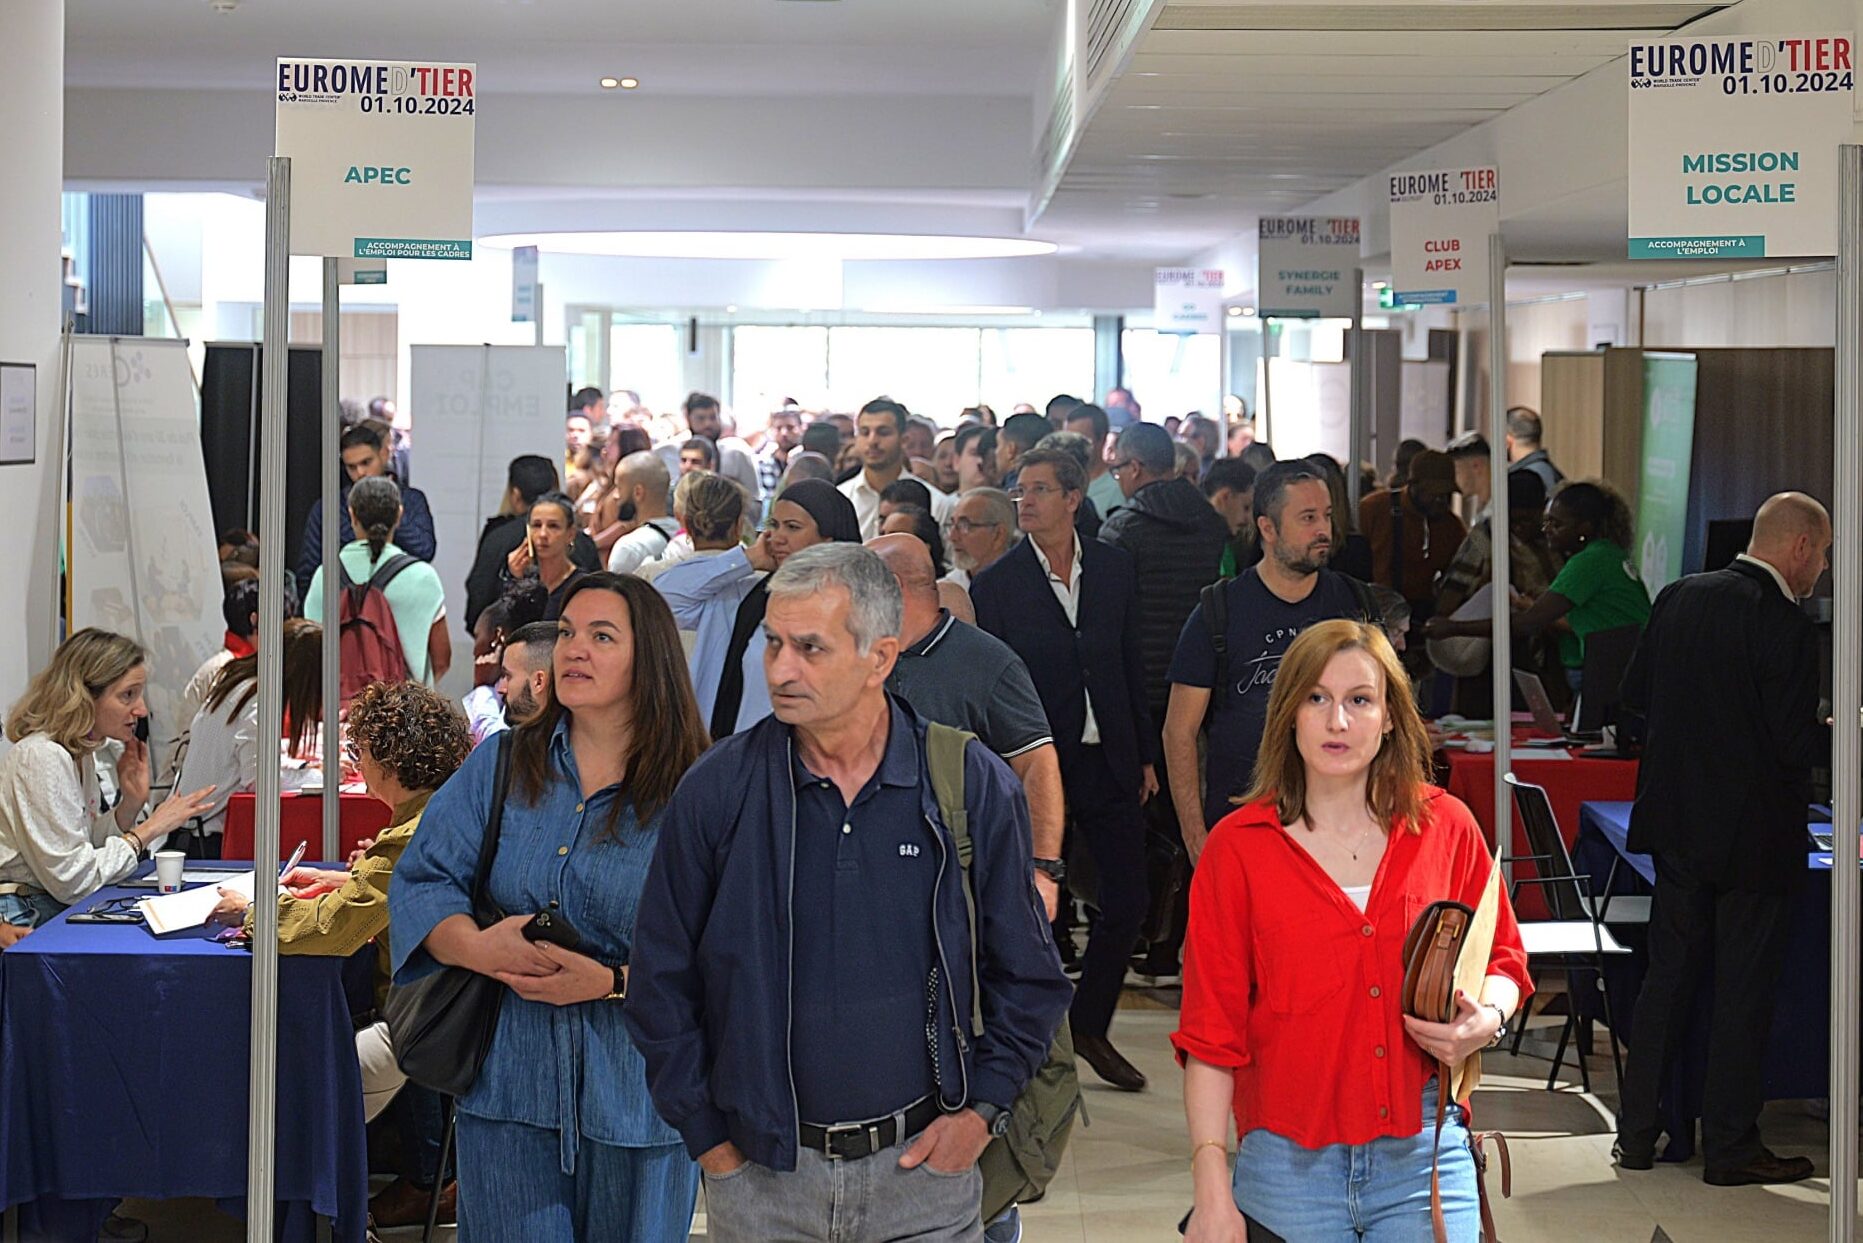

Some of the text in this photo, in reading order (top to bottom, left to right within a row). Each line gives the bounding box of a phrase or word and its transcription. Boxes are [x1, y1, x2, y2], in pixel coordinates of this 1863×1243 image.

[1723, 72, 1853, 94] 01.10.2024
[361, 96, 475, 115] 01.10.2024
[1682, 152, 1799, 173] MISSION
[344, 166, 412, 185] APEC
[1434, 190, 1497, 205] 01.10.2024
[1686, 183, 1796, 205] LOCALE
[367, 242, 460, 251] ACCOMPAGNEMENT À
[1424, 239, 1461, 252] CLUB
[1648, 238, 1746, 248] ACCOMPAGNEMENT À
[359, 248, 396, 256] L'EMPLOI
[1677, 247, 1718, 255] L'EMPLOI
[1425, 258, 1462, 272] APEX
[1278, 270, 1340, 282] SYNERGIE
[1286, 284, 1333, 296] FAMILY
[899, 844, 920, 857] GAP
